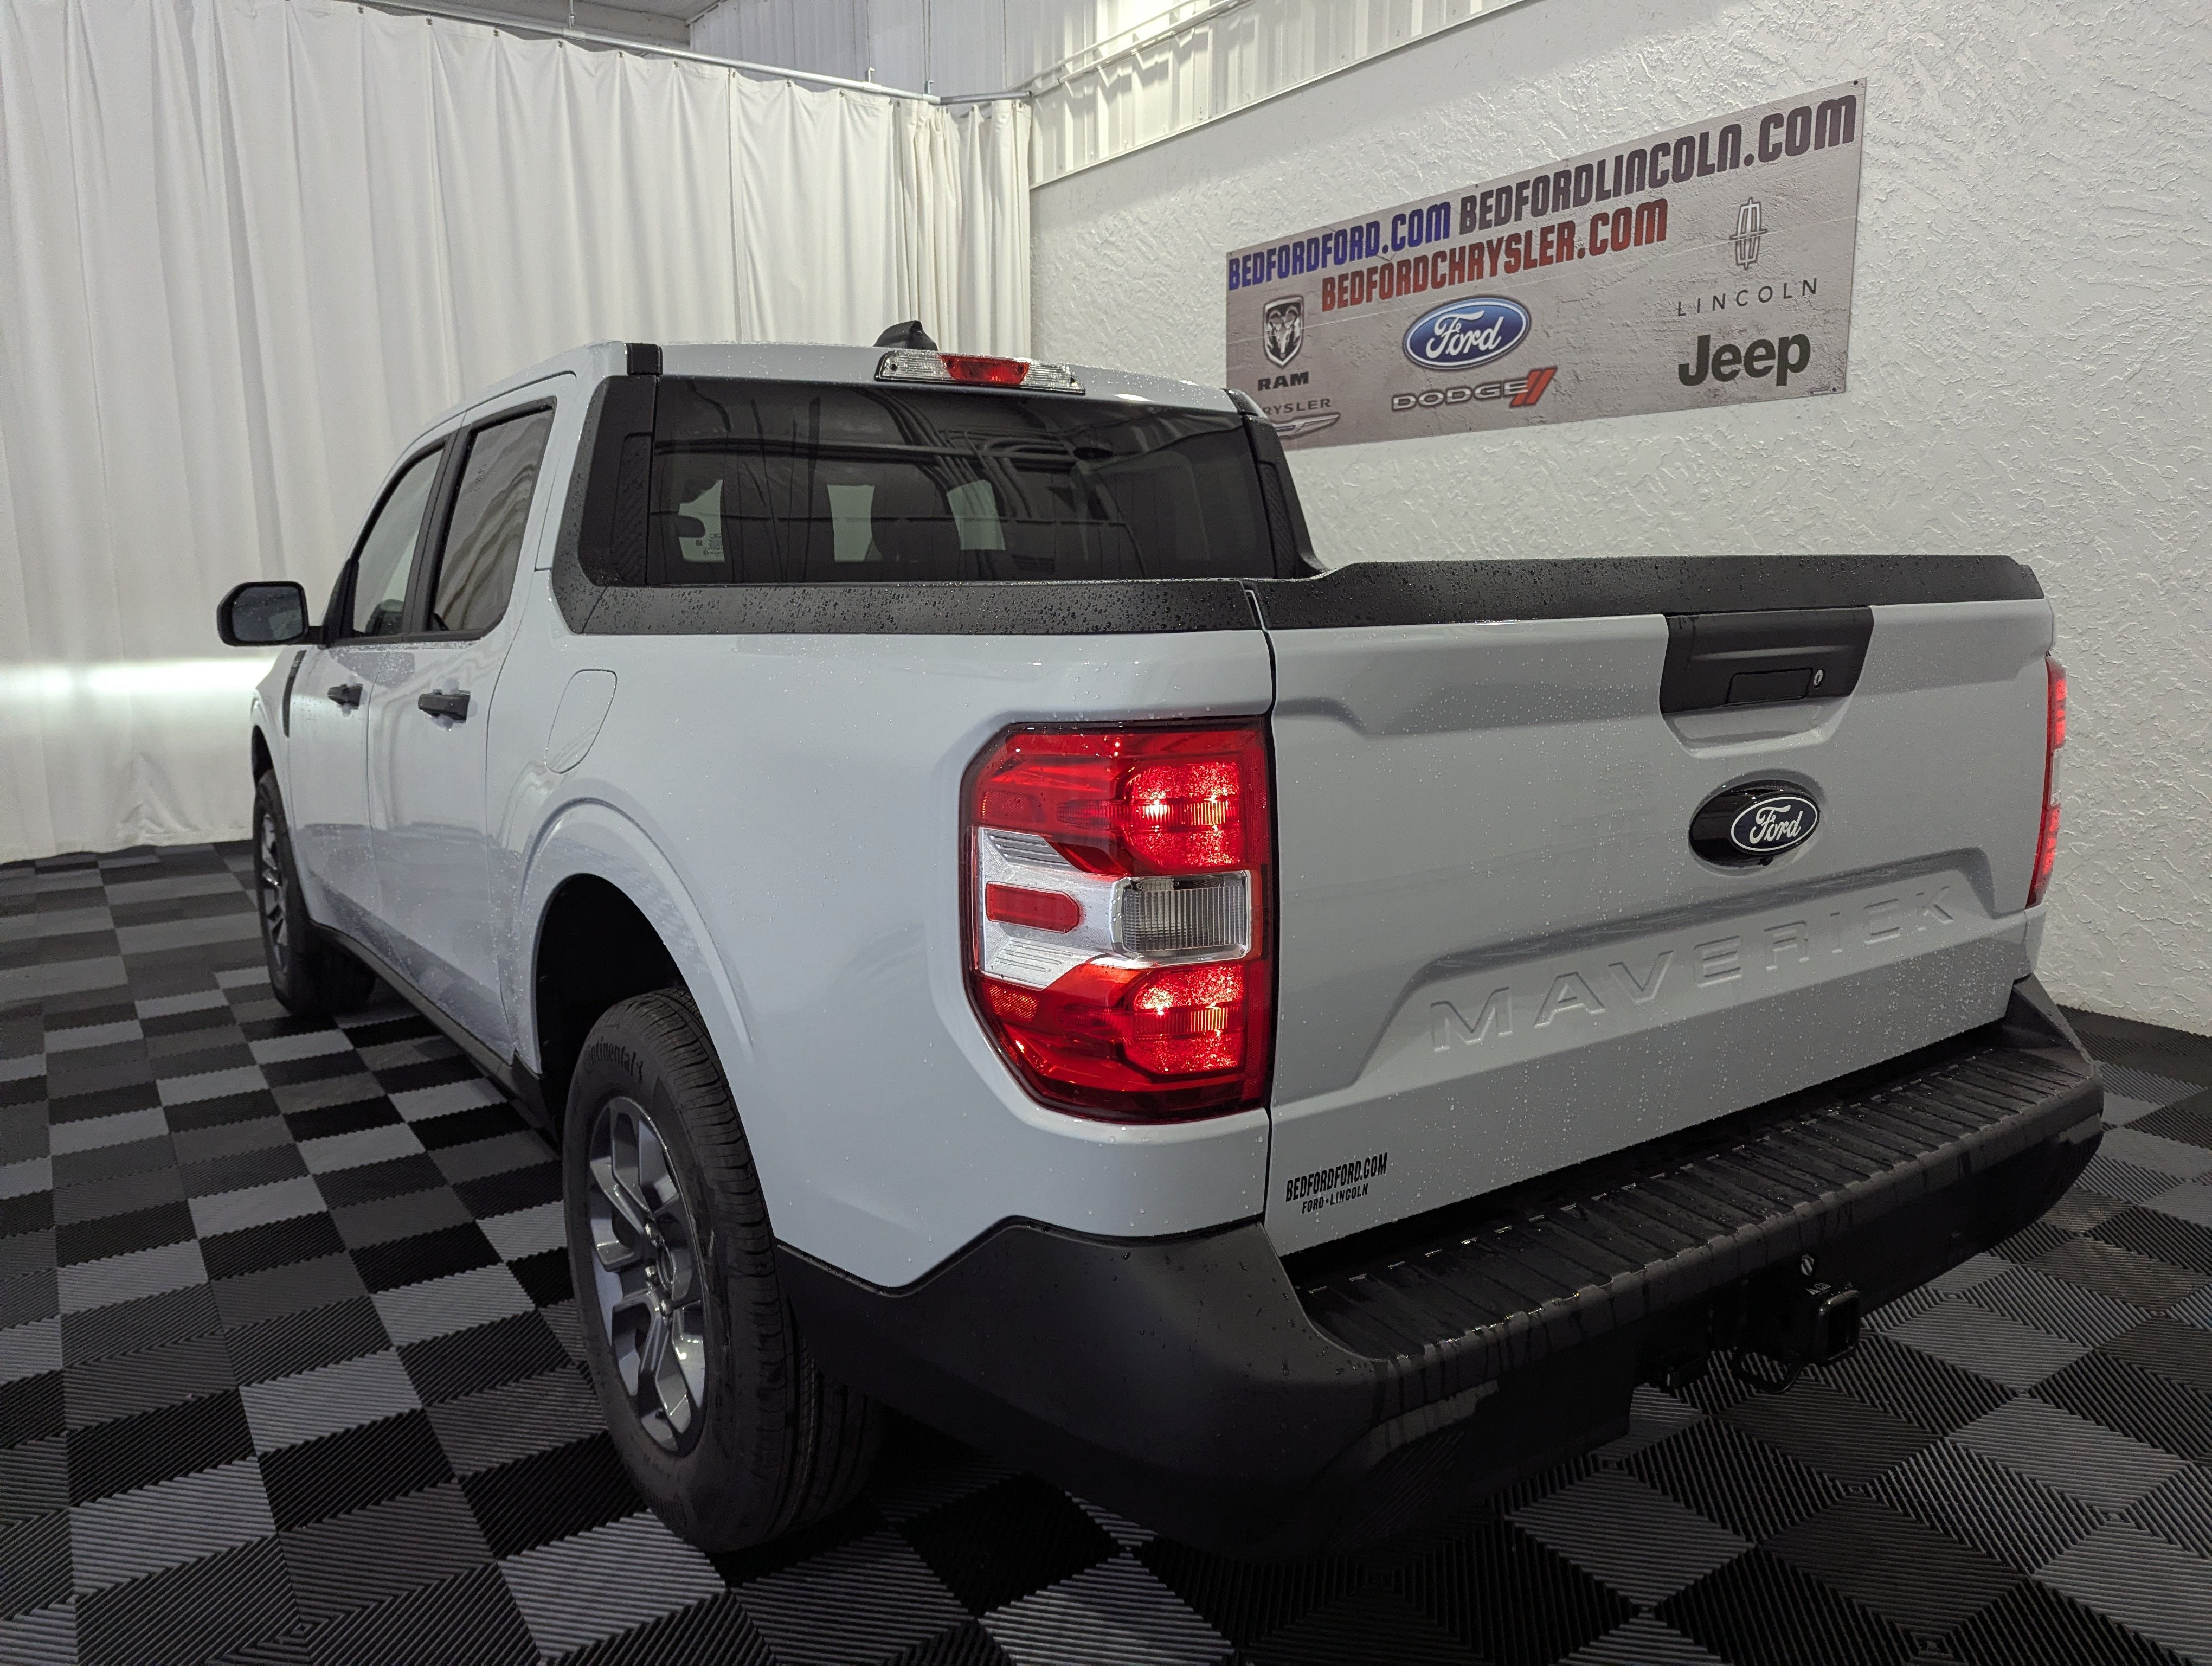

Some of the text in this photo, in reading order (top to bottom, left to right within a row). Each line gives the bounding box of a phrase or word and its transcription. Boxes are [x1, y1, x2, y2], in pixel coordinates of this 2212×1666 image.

[1228, 94, 1857, 291] BEDFORDFORD.COM BEDFORDLINCOLN.COM
[1321, 198, 1668, 312] BEDFORDCHRYSLER.COM
[1677, 277, 1817, 317] LINCOLN
[1425, 310, 1504, 358] Ford
[1257, 371, 1309, 392] RAM
[1678, 334, 1811, 387] Jeep
[1263, 399, 1331, 415] RYSLER
[1392, 379, 1530, 411] DODGE
[1749, 805, 1804, 844] Ford
[1430, 885, 1955, 1053] MAVERICK
[1285, 1152, 1388, 1202] BEDFORDFORD.COM
